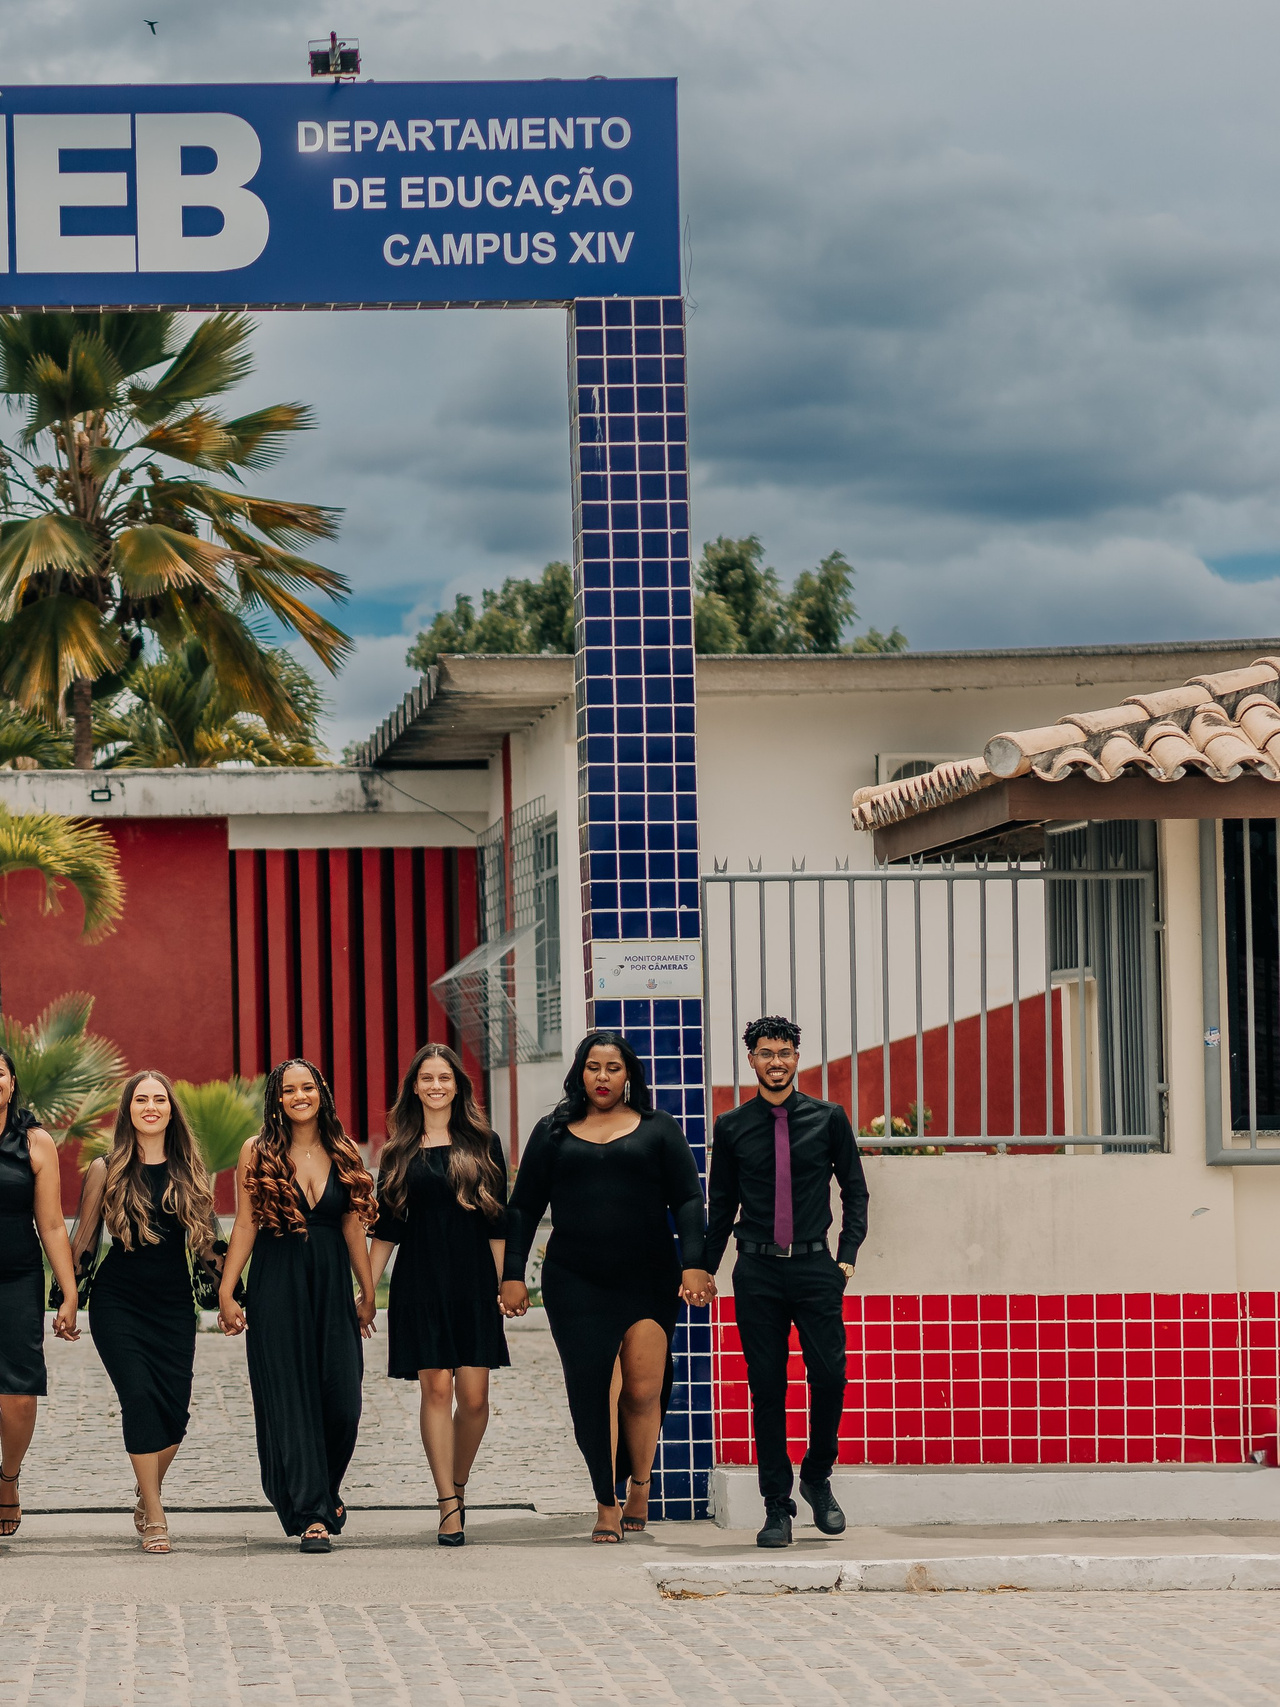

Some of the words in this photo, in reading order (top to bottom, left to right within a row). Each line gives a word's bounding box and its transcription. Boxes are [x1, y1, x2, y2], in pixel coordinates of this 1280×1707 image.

[297, 116, 632, 154] DEPARTAMENTO
[332, 177, 387, 210] DE
[400, 166, 633, 215] EDUCAÇÃO
[382, 231, 557, 267] CAMPUS
[568, 231, 635, 264] XIV
